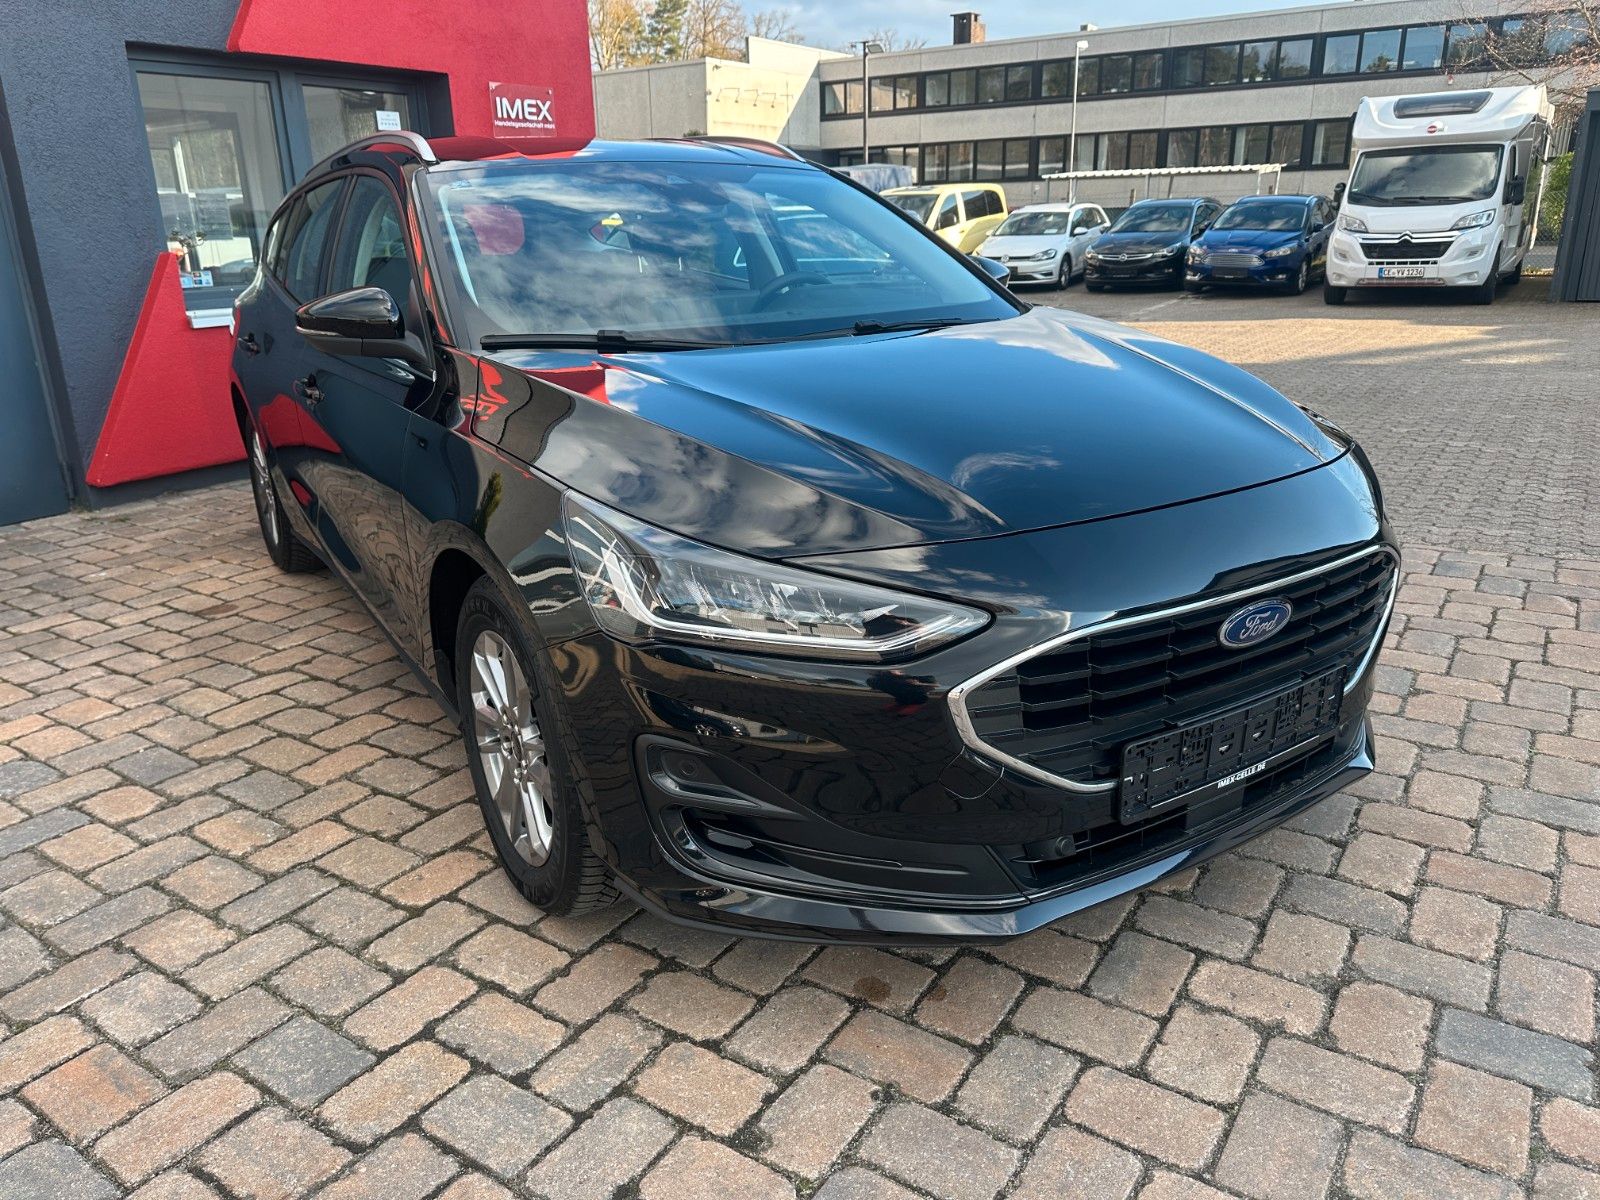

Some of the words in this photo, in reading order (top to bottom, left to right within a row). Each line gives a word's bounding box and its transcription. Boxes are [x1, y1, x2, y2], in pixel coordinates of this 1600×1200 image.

[495, 96, 553, 121] IMEX
[1383, 268, 1392, 276] CE
[1396, 268, 1406, 276] YV
[1406, 268, 1423, 276] 1236
[1239, 610, 1279, 640] Ford
